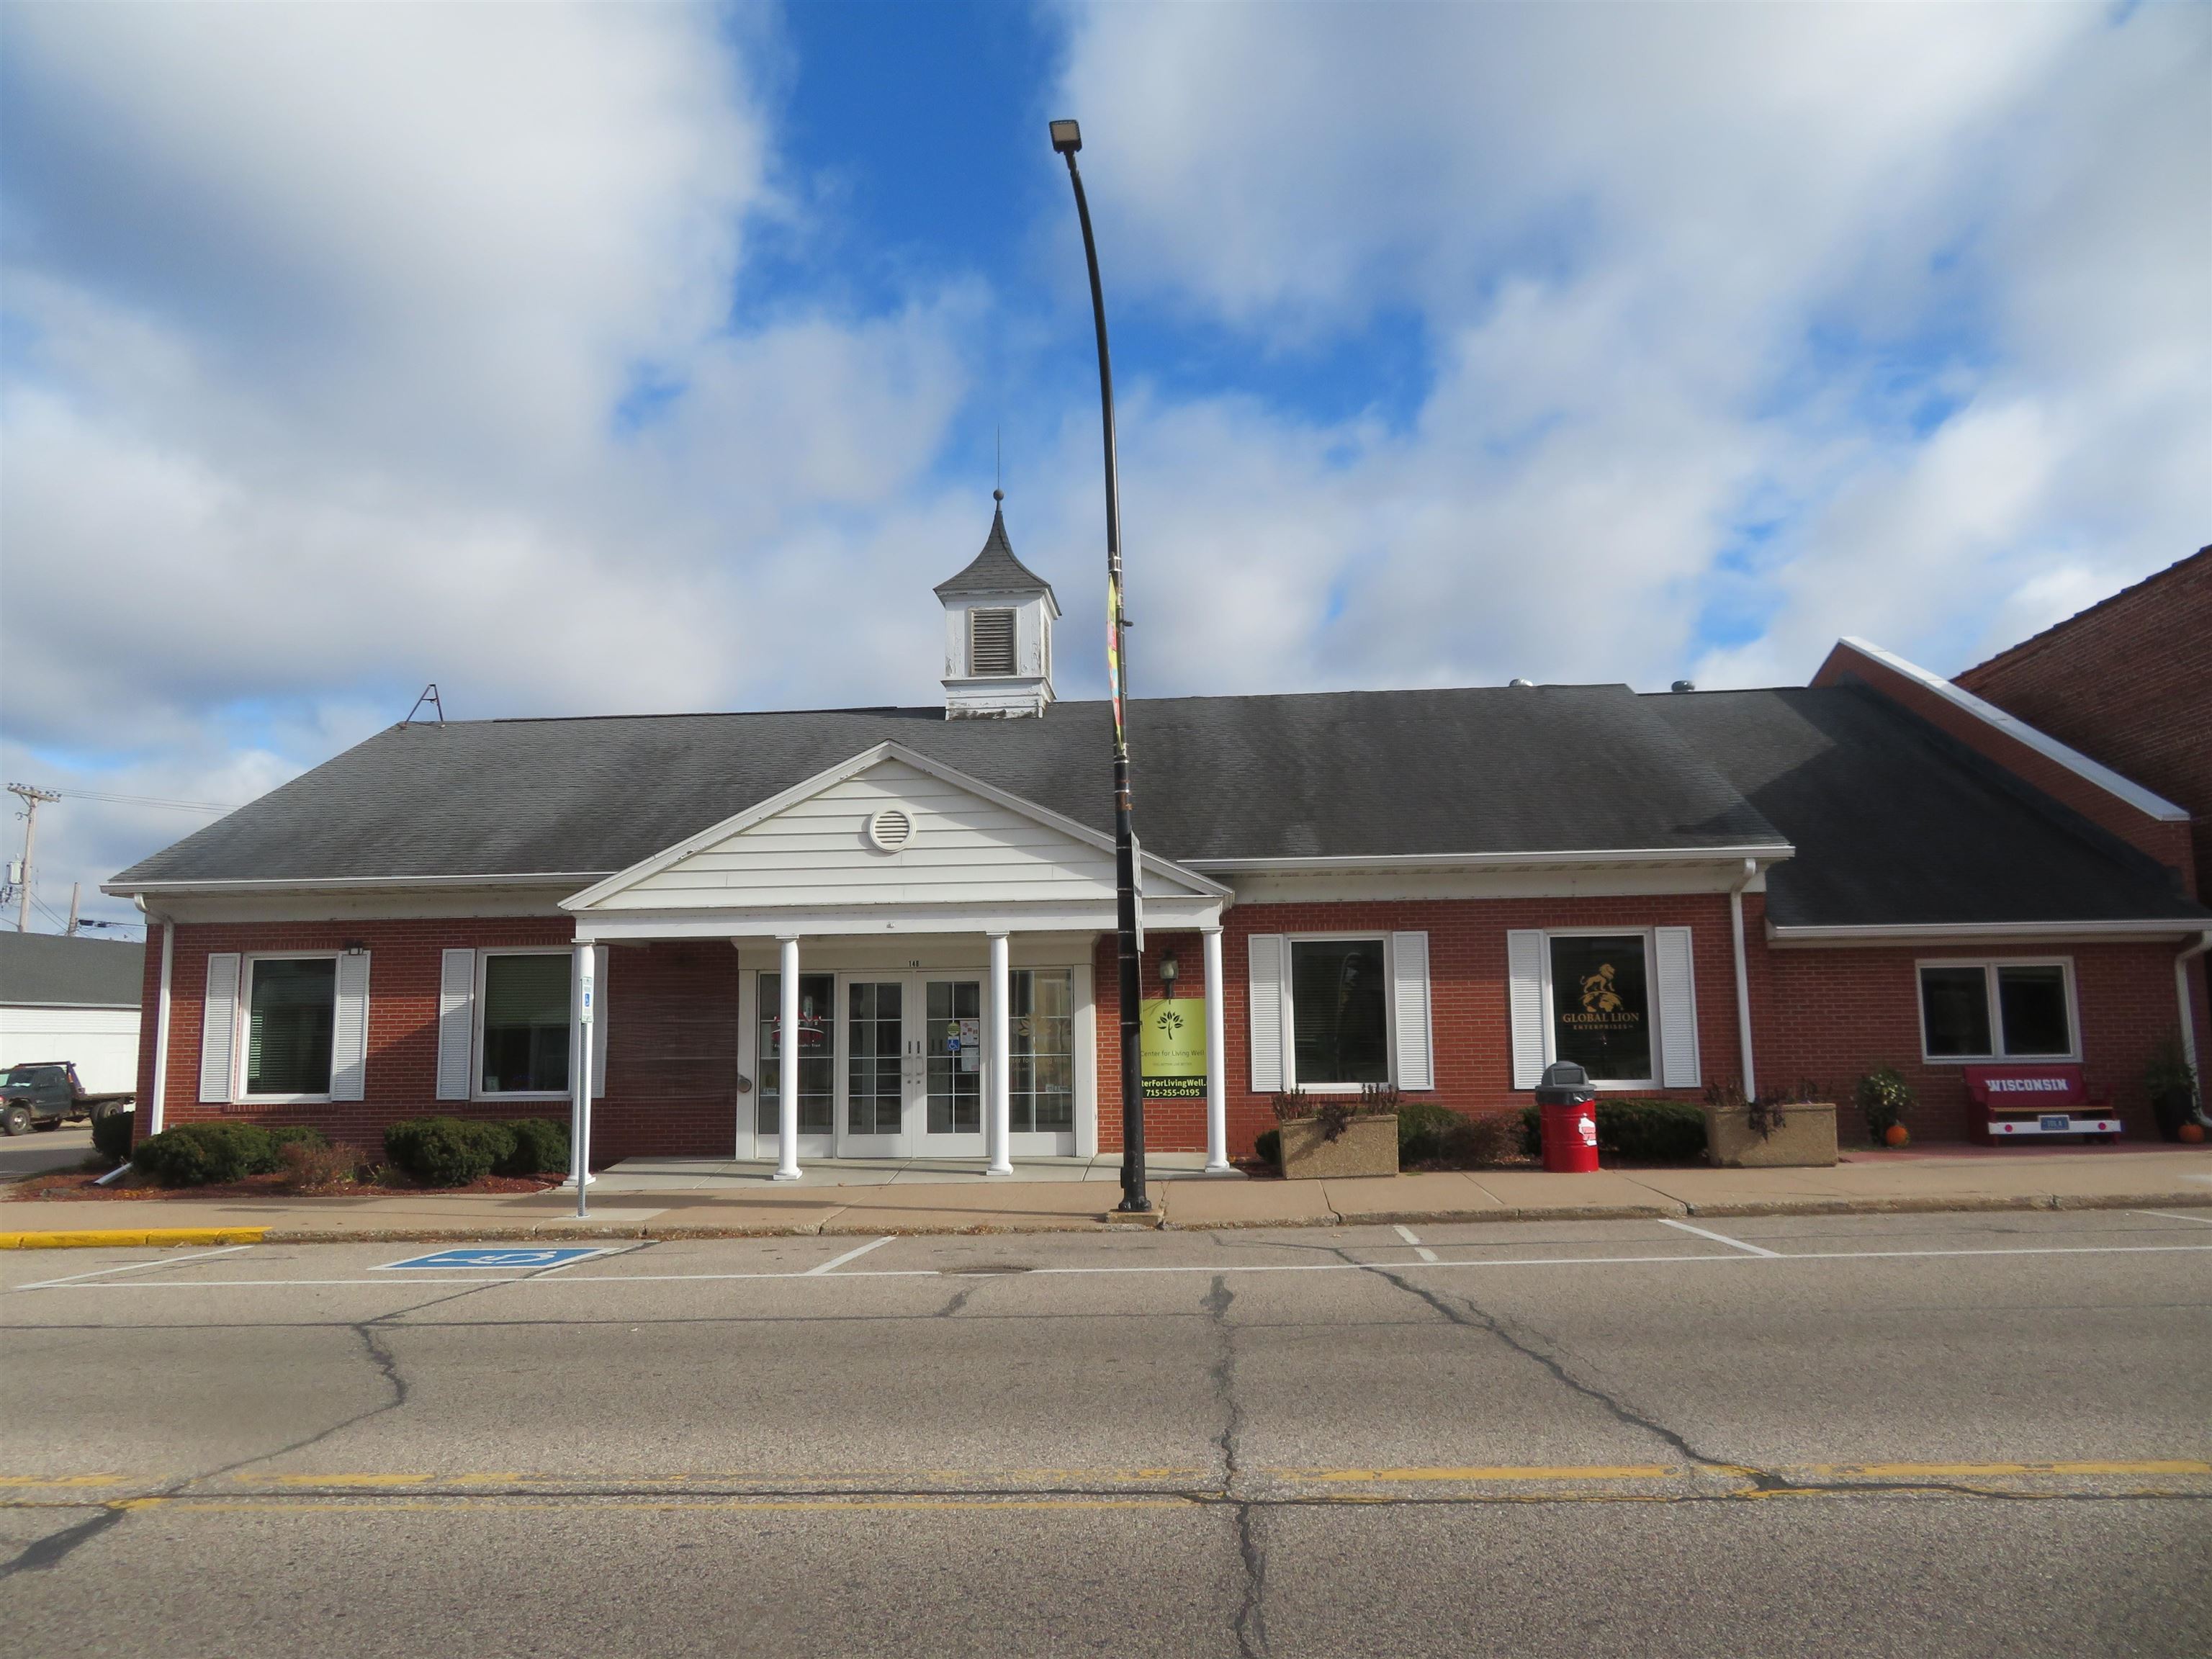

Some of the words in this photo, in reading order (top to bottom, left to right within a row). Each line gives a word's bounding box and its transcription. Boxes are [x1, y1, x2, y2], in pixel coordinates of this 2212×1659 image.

[1563, 1012, 1609, 1022] GLOBAL
[1611, 1012, 1640, 1022] LION
[1985, 1078, 2069, 1092] WISCONSIN
